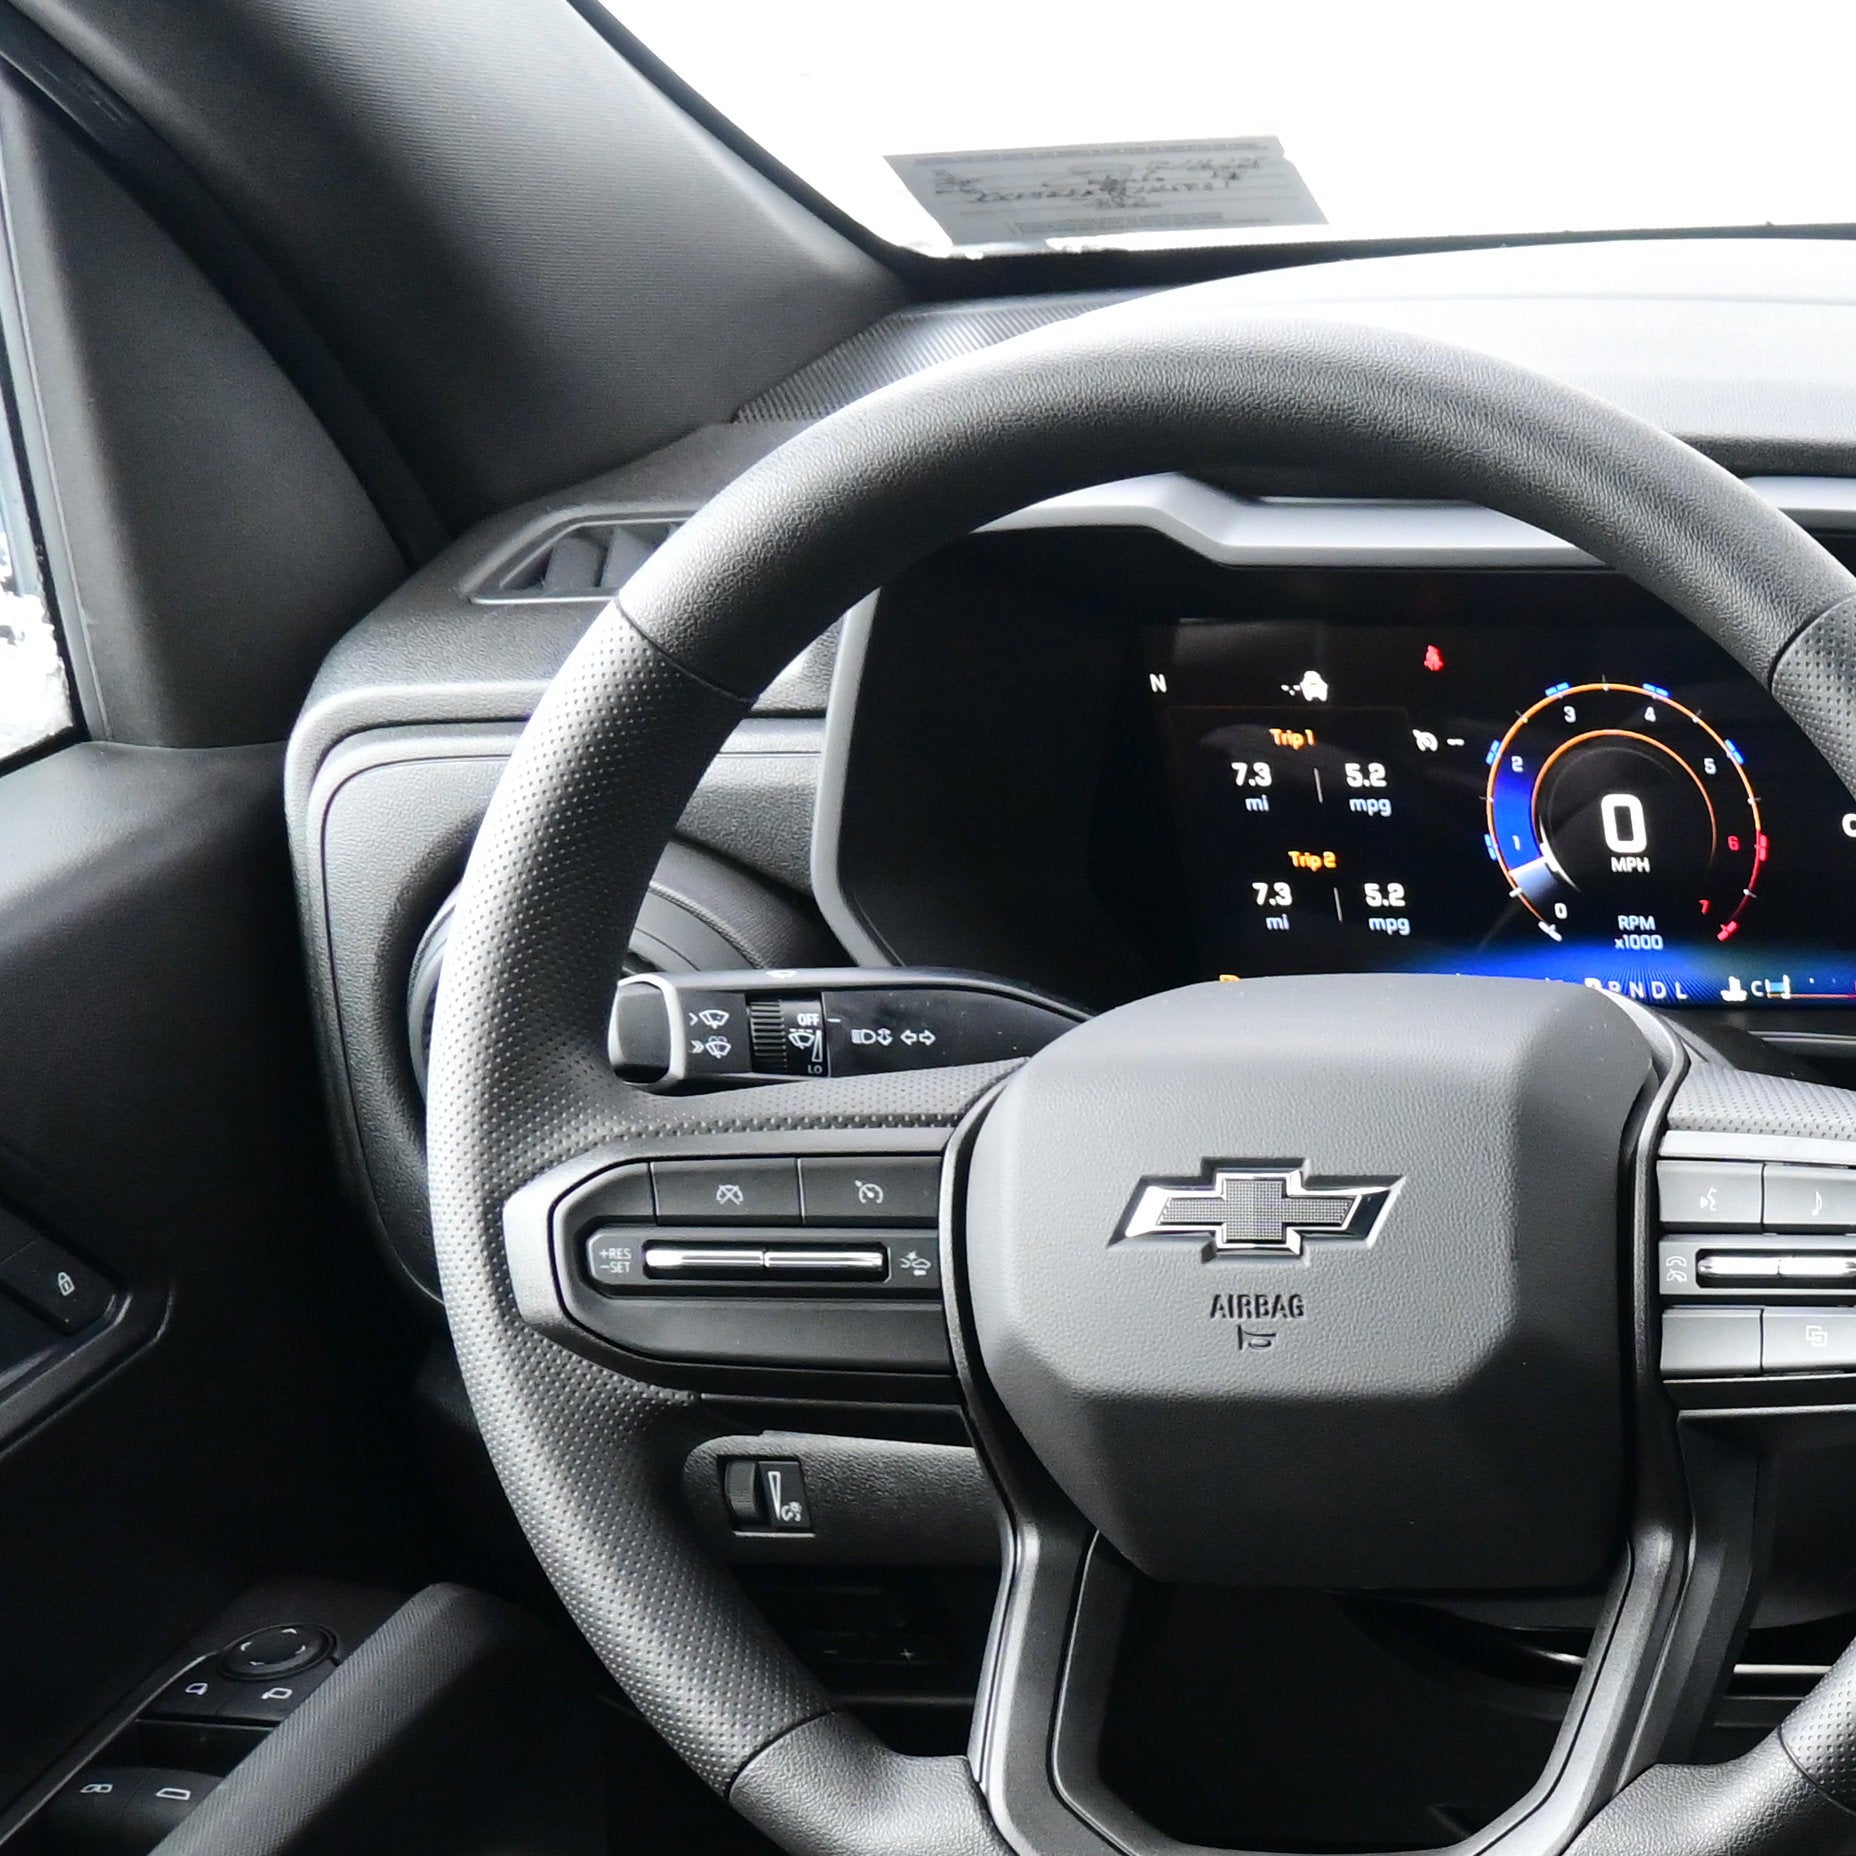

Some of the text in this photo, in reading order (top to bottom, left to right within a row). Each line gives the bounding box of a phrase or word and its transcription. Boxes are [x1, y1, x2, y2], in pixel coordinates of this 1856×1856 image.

[1149, 673, 1168, 693] N
[1563, 705, 1576, 723] 3
[1643, 705, 1656, 722] 4
[1269, 728, 1316, 749] Trip 1
[1510, 755, 1523, 772] 2
[1703, 757, 1716, 774] 5
[1231, 762, 1273, 787] 7.3
[1345, 763, 1388, 788] 5.2
[1245, 794, 1269, 811] mi
[1349, 798, 1391, 816] mpg
[1600, 792, 1648, 854] 0
[1511, 834, 1520, 850] 1
[1727, 834, 1740, 851] 6
[1288, 850, 1337, 871] Trip 2
[1610, 857, 1650, 873] MPH
[1252, 881, 1294, 906] 7.3
[1364, 883, 1406, 908] 5.2
[1554, 902, 1568, 919] 0
[1698, 899, 1710, 915] 7
[1266, 913, 1289, 930] mi
[1368, 917, 1410, 935] mpg
[1617, 915, 1655, 930] RPM
[1614, 934, 1663, 949] x1000
[796, 1012, 819, 1026] OFF
[599, 1248, 631, 1260] +RES
[1209, 1293, 1306, 1320] AIRBAG
